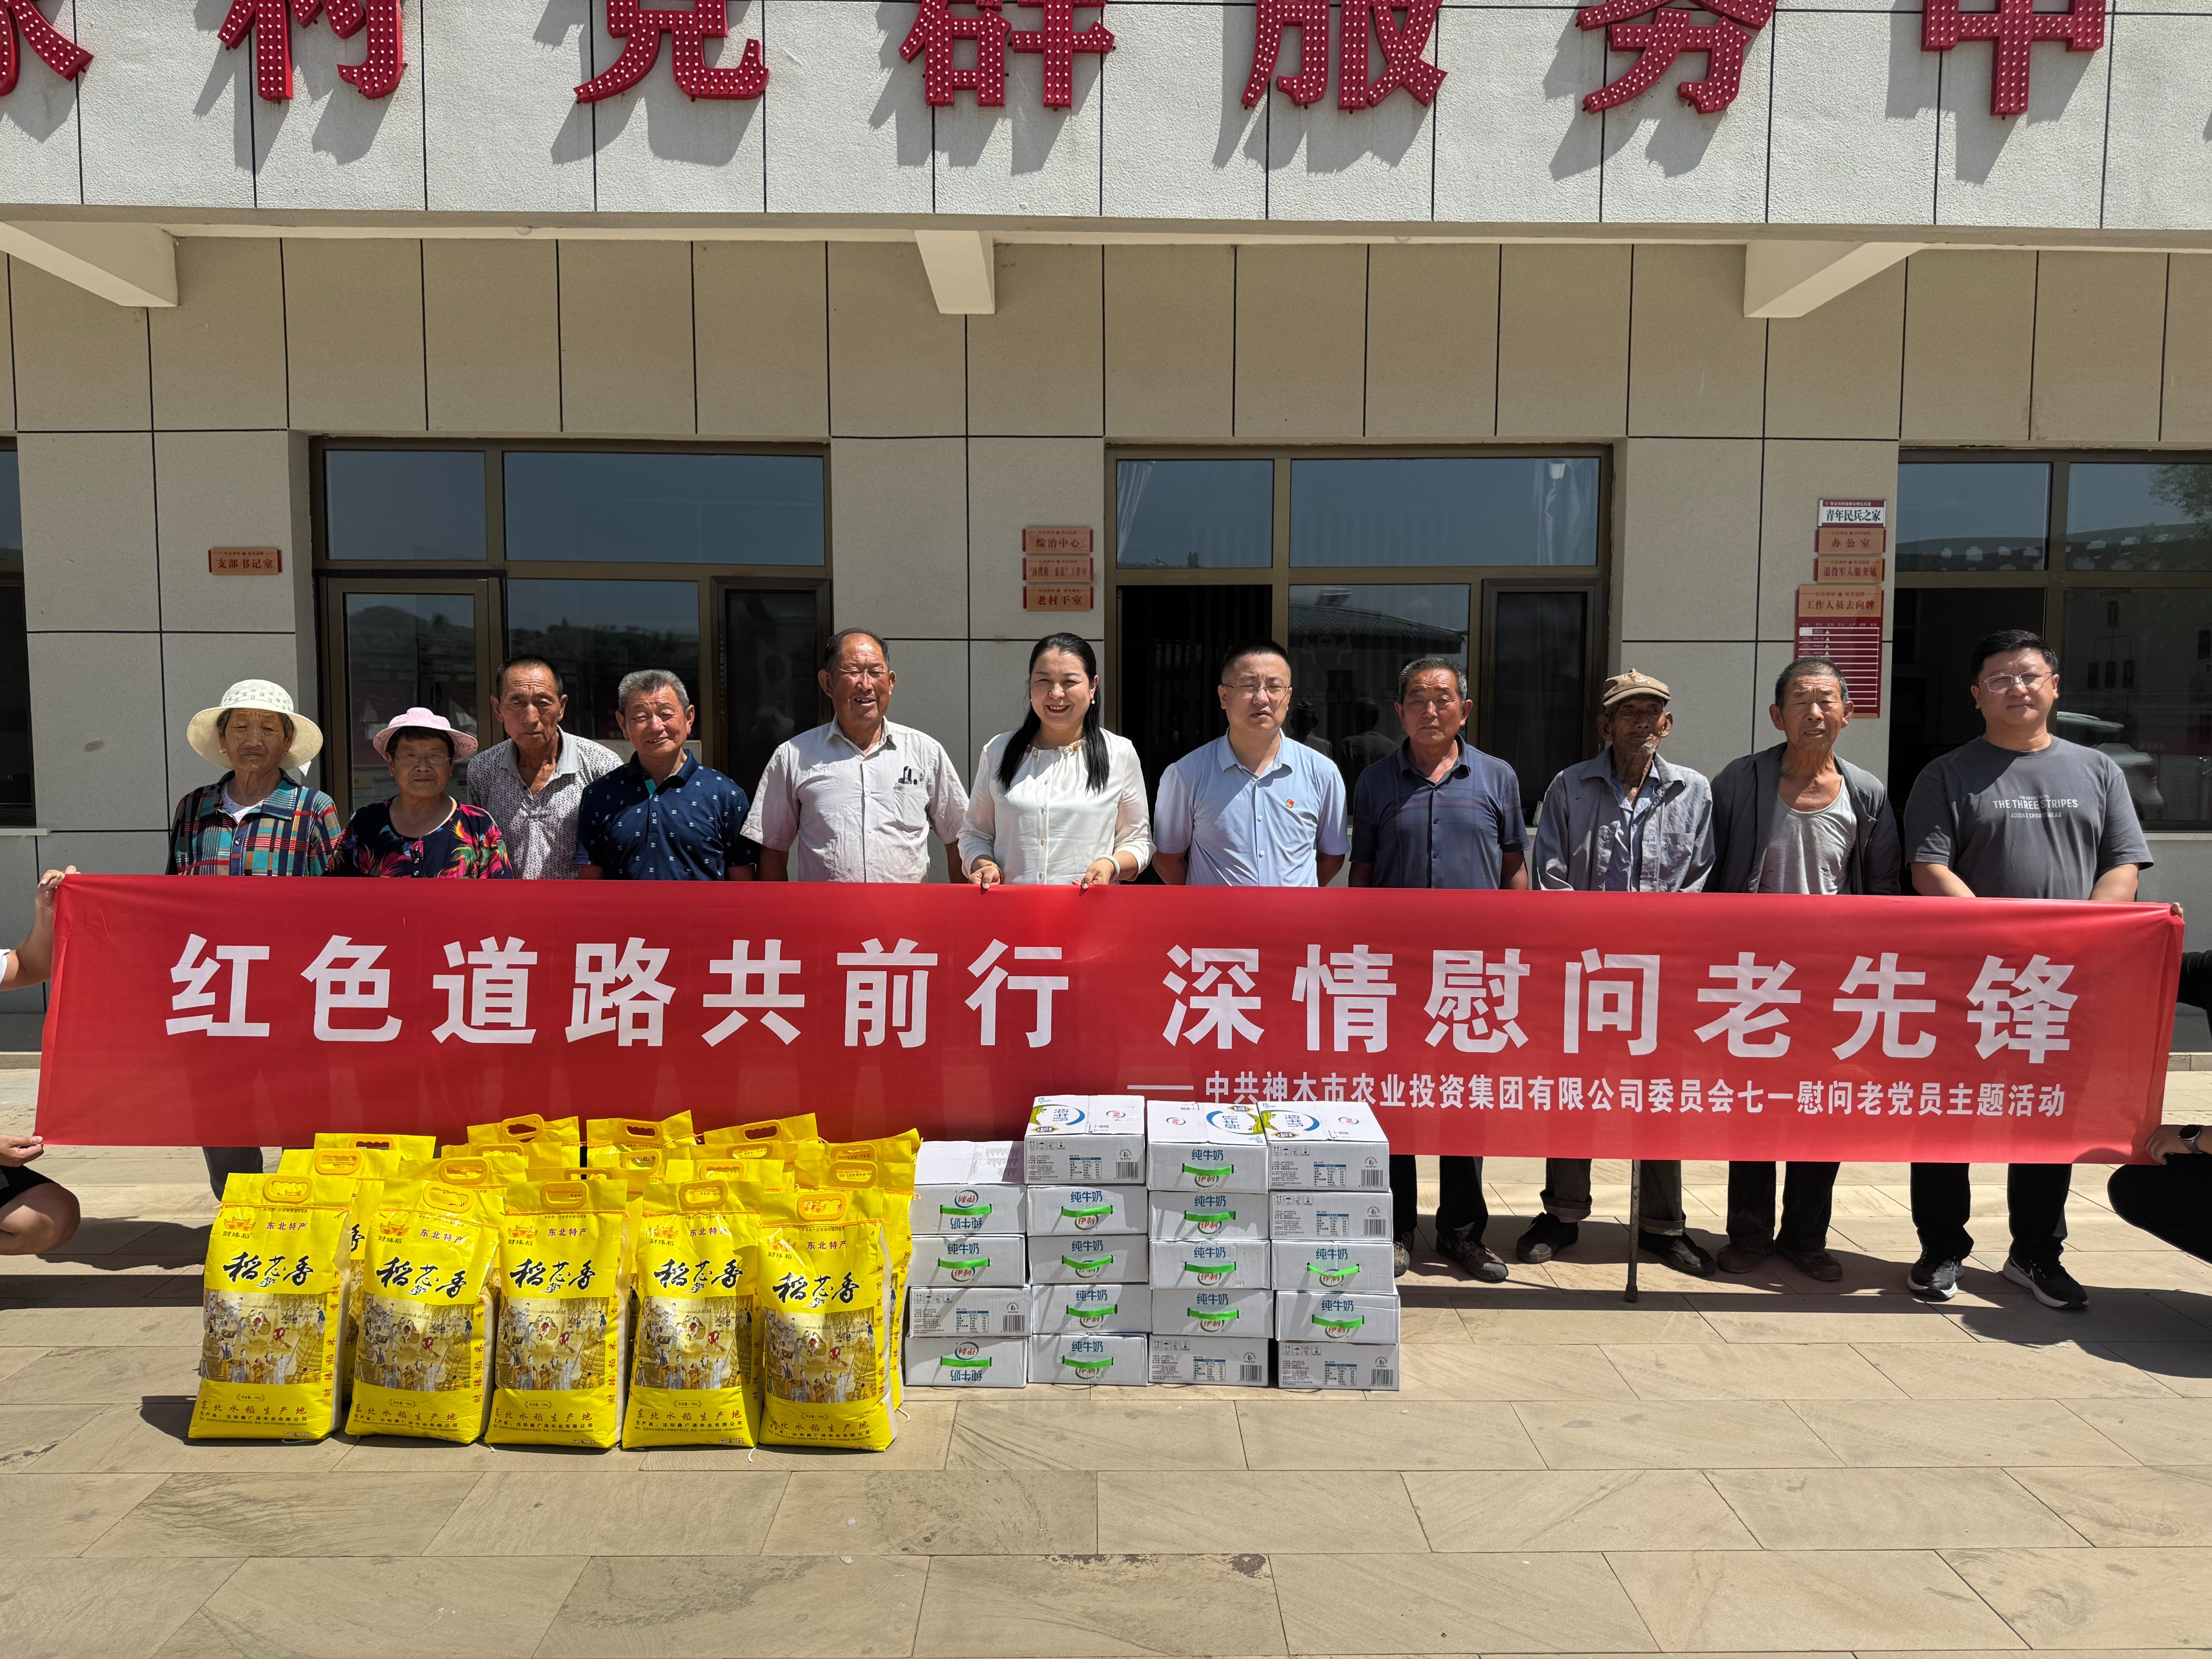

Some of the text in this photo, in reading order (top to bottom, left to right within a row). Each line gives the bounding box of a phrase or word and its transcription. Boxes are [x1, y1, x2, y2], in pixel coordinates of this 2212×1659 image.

[1826, 509, 1881, 522] 青年民兵之家
[1036, 538, 1079, 548] 综治中心
[1831, 538, 1870, 548] 办公室
[217, 559, 273, 569] 支部书记室
[1823, 566, 1877, 576] 退役军人服务站
[1806, 600, 1875, 610] 工作人员去向牌
[1993, 799, 2078, 810] THE THREE STRIPES
[165, 933, 2079, 1064] 红色道路共前行 深情慰问老先锋
[1192, 1149, 1224, 1161] 纯牛奶
[958, 1195, 975, 1203] 伊利
[1070, 1191, 1103, 1203] 纯牛奶
[1194, 1195, 1226, 1207] 纯牛奶
[266, 1222, 307, 1231] 东北特产
[951, 1217, 983, 1229] 纯牛奶
[419, 1228, 464, 1243] 东北特产
[548, 1228, 587, 1237] 东北特产
[806, 1240, 848, 1250] 东北特产
[947, 1243, 980, 1255] 纯牛奶
[1072, 1240, 1103, 1252] 纯牛奶
[1194, 1247, 1226, 1258] 纯牛奶
[1316, 1248, 1348, 1260] 纯牛奶
[955, 1268, 972, 1277] 伊利
[1076, 1289, 1107, 1301] 纯牛奶
[1197, 1293, 1229, 1305] 纯牛奶
[1321, 1300, 1354, 1311] 纯牛奶
[1072, 1341, 1103, 1352] 纯牛奶
[951, 1370, 983, 1381] 纯牛奶
[201, 1400, 307, 1415] 东北水稻生产地
[355, 1403, 458, 1422] 东北水稻生产地
[495, 1407, 592, 1423] 东北水稻生产地
[637, 1408, 742, 1422] 东北水稻生产地
